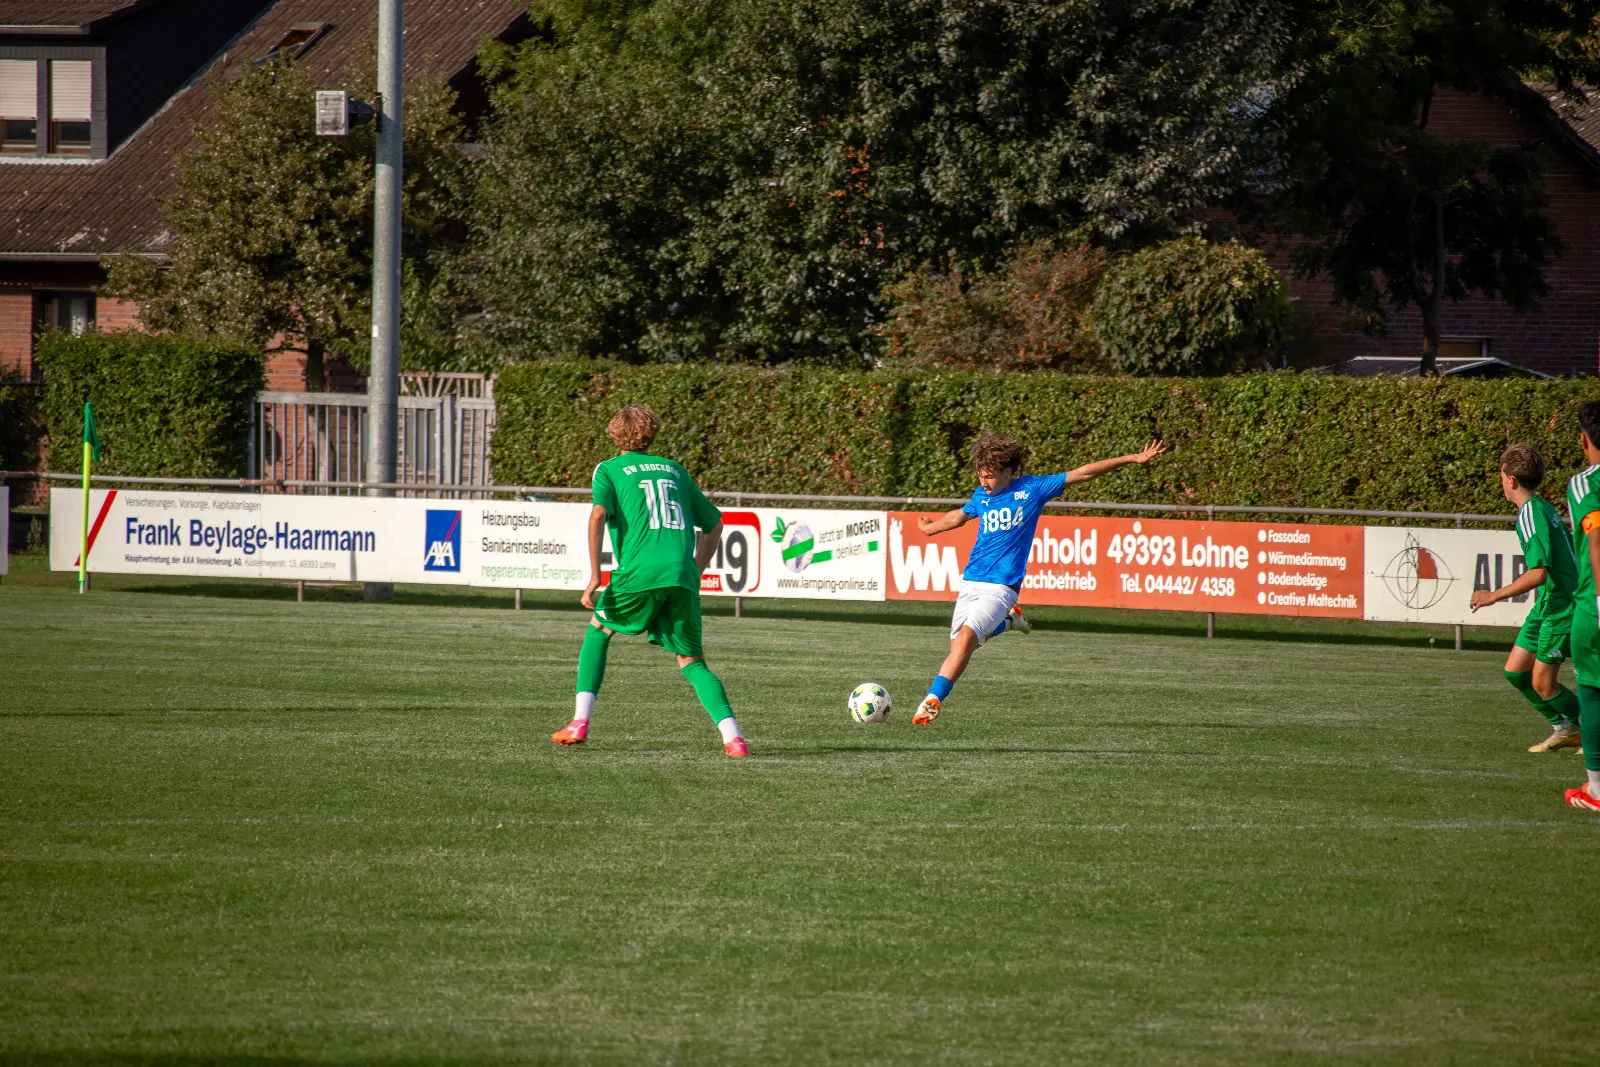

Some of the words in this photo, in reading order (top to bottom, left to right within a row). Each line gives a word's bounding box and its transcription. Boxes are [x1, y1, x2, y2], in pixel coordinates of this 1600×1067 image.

[623, 465, 638, 475] GW
[212, 500, 261, 512] Kapitalanlagen
[638, 479, 685, 530] 16
[482, 510, 540, 531] Heizungsbau
[983, 506, 1024, 533] 1894
[126, 517, 181, 546] Frank
[190, 519, 375, 555] Beylage-Haarmann
[819, 530, 835, 543] Jetzt
[836, 529, 844, 540] an
[846, 519, 880, 537] MORGEN
[1268, 529, 1310, 543] Fassaden
[424, 541, 455, 567] AXA
[482, 537, 567, 555] Sanitärinstallation
[1028, 528, 1097, 566] nhold
[1107, 534, 1176, 567] 49393
[1181, 536, 1249, 569] Lohne
[124, 554, 170, 566] Hauptvertretung
[172, 555, 181, 564] der
[182, 556, 194, 565] AXA
[196, 557, 232, 567] Versicherung
[320, 561, 336, 570] Lohne
[1268, 551, 1346, 570] Wärmedämmung
[481, 564, 539, 582] regenerative
[542, 564, 583, 584] Energien
[701, 576, 719, 589] mbH
[1021, 569, 1097, 591] achbetrieb
[1268, 571, 1328, 590] Bodenbeläge
[1473, 553, 1538, 603] ALB
[777, 576, 878, 593] www.lamping-online.de
[1120, 573, 1142, 593] Tel.
[1145, 574, 1198, 595] 04442/
[1200, 577, 1235, 597] 4358
[1268, 591, 1306, 606] Creative
[1307, 593, 1357, 608] Maltechnik
